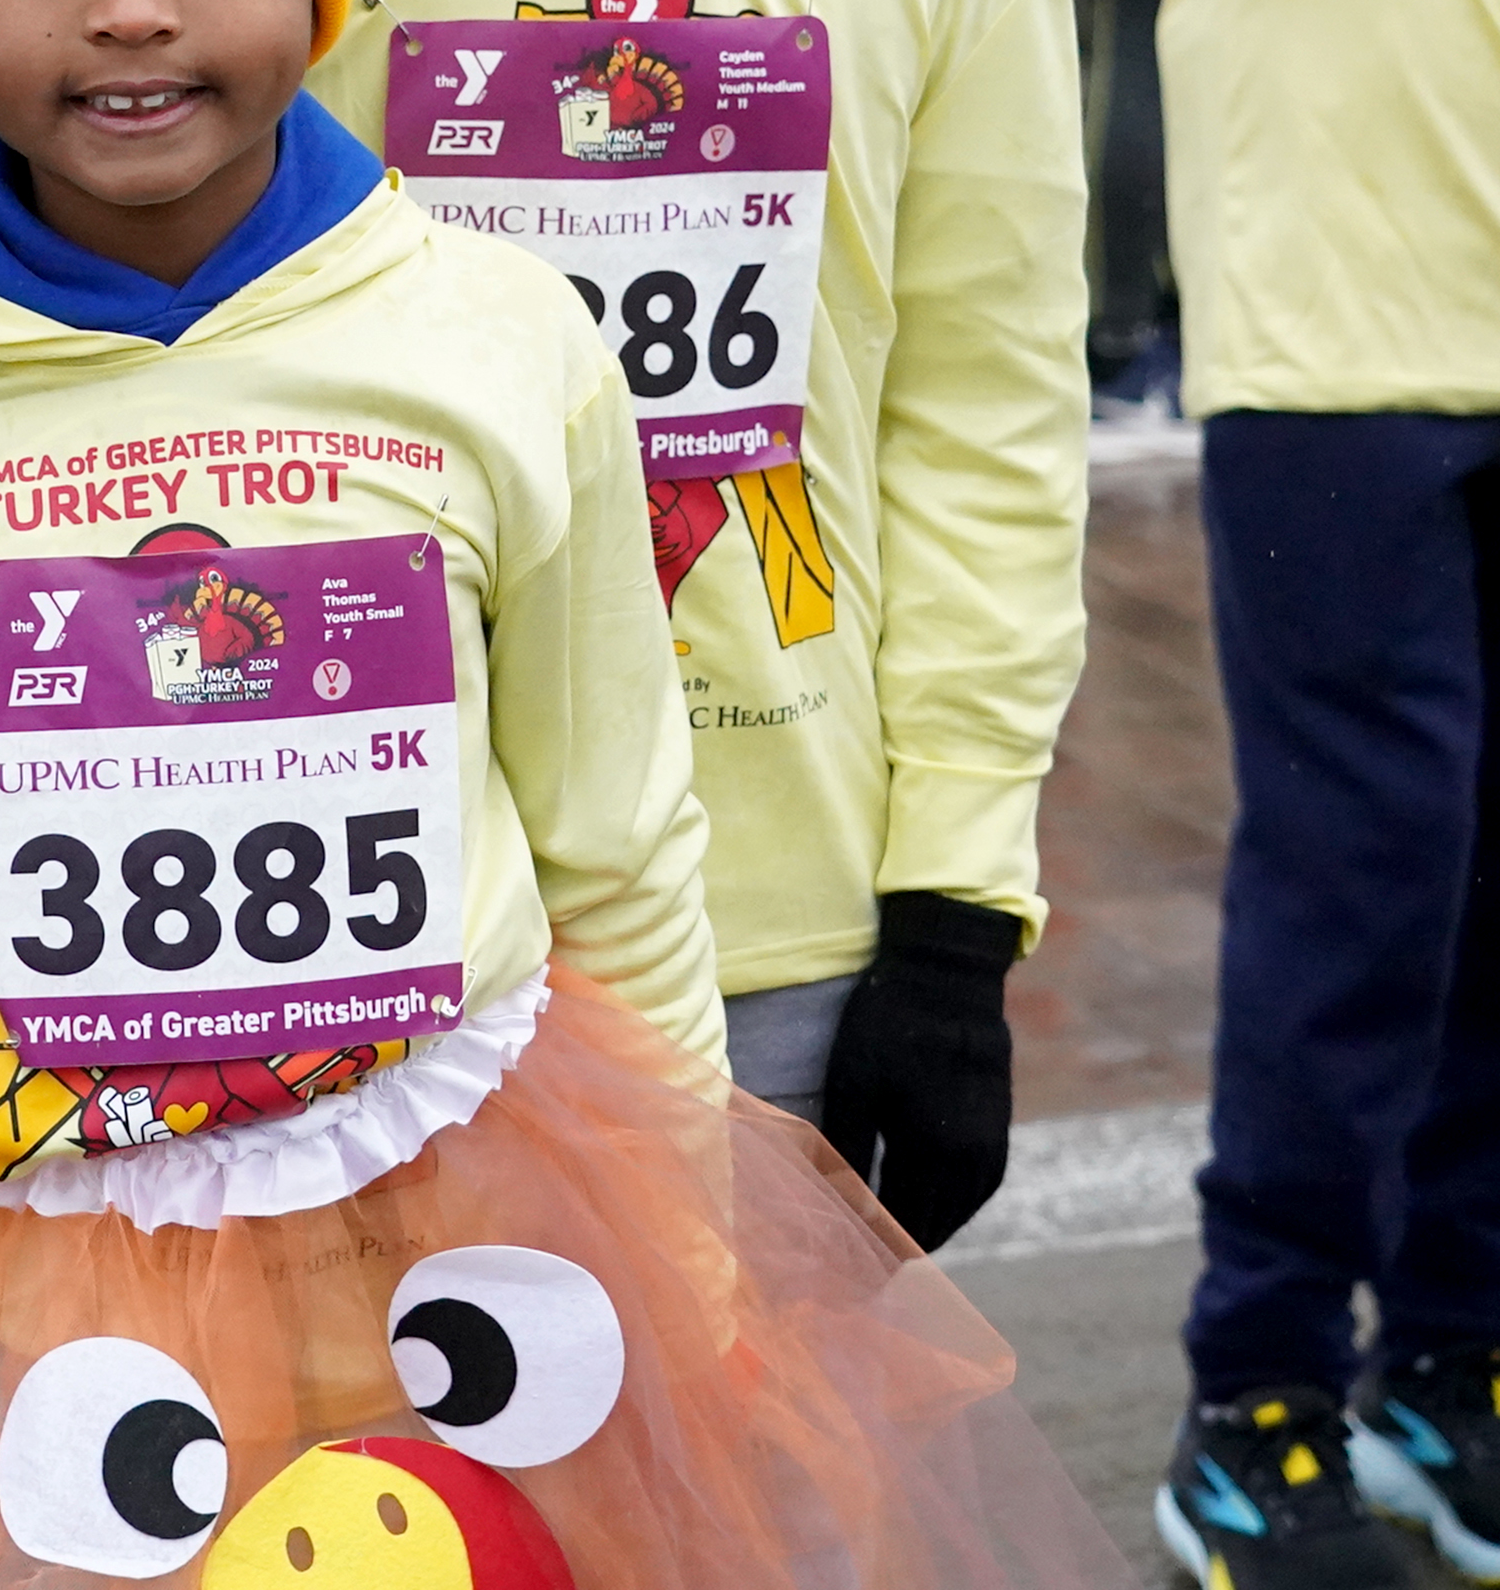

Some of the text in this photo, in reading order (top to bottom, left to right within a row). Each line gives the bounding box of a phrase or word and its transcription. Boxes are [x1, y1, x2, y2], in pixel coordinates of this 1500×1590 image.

[719, 50, 765, 64] Cayden
[719, 67, 767, 78] Thomas
[435, 74, 458, 88] the
[719, 80, 806, 94] Youth Medium
[717, 98, 748, 109] M 11
[649, 122, 675, 134] 2024
[605, 129, 644, 142] YMCA
[742, 192, 795, 227] 5K
[566, 263, 779, 398] 86
[650, 423, 769, 460] Pittsburgh
[67, 447, 98, 476] of
[106, 429, 246, 471] GREATER
[256, 430, 444, 473] PITTSBURGH
[207, 461, 349, 507] TROT
[322, 578, 348, 590] Ava
[322, 593, 377, 607] Thomas
[323, 605, 404, 624] Youth Small
[10, 619, 35, 633] the
[135, 611, 165, 633] 34th
[324, 628, 352, 642] F 7
[248, 659, 279, 671] 2024
[196, 667, 243, 682] YMCA
[243, 679, 273, 690] TROT
[694, 678, 710, 693] By
[173, 693, 206, 704] UPMC
[370, 728, 429, 771] 5K
[10, 808, 427, 977] 3885
[22, 987, 426, 1044] YMCA of Greater Pittsburgh
